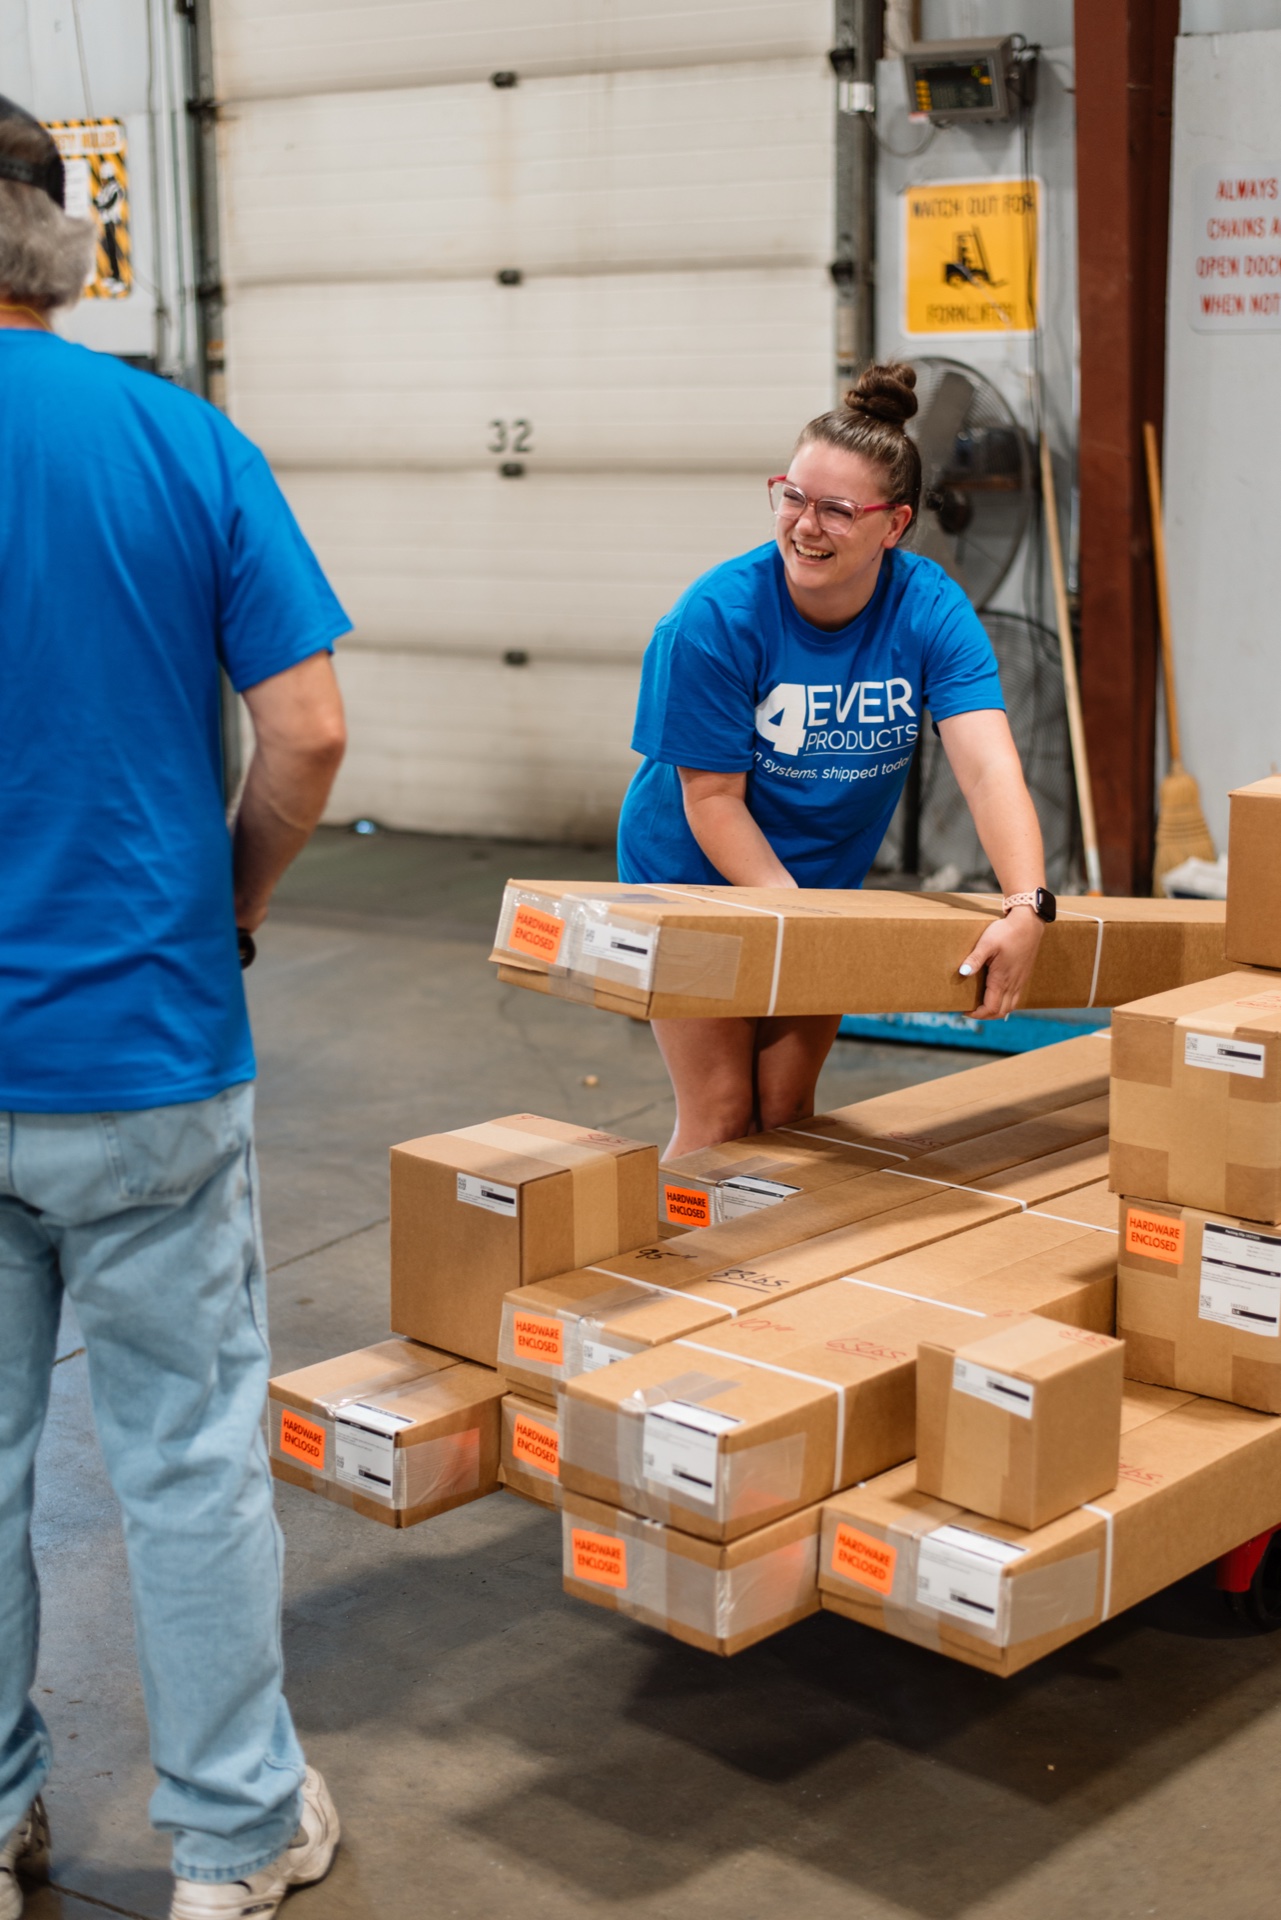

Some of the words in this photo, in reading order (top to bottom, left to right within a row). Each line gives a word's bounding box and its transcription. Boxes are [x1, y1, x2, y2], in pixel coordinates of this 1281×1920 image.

[1216, 177, 1278, 201] ALWAYS
[967, 196, 999, 216] OUT
[1206, 216, 1266, 241] CHAINS
[1196, 255, 1240, 279] OPEN
[1244, 254, 1281, 278] DOC
[1200, 293, 1245, 316] WHEN
[1250, 292, 1280, 316] NOT
[486, 418, 534, 454] 32
[805, 723, 918, 751] PRODUCTS
[822, 765, 878, 782] shipped
[516, 912, 561, 938] HARDWARE
[514, 927, 555, 951] ENCLOSED
[666, 1191, 706, 1208] HARDWARE
[669, 1203, 706, 1220] ENCLOSED
[1129, 1216, 1180, 1240] HARDWARE
[1131, 1231, 1177, 1253] ENCLOSED
[516, 1320, 560, 1340] HARDWARE
[518, 1335, 558, 1354] ENCLOSED
[283, 1417, 322, 1446] HARDWARE
[516, 1422, 559, 1451] HARDWARE
[284, 1432, 320, 1458] ENCLOSED
[517, 1437, 556, 1464] ENCLOSED
[574, 1538, 621, 1560] HARDWARE
[838, 1533, 891, 1568] HARDWARE
[577, 1554, 620, 1575] ENCLOSED
[838, 1550, 887, 1581] ENCLOSED
